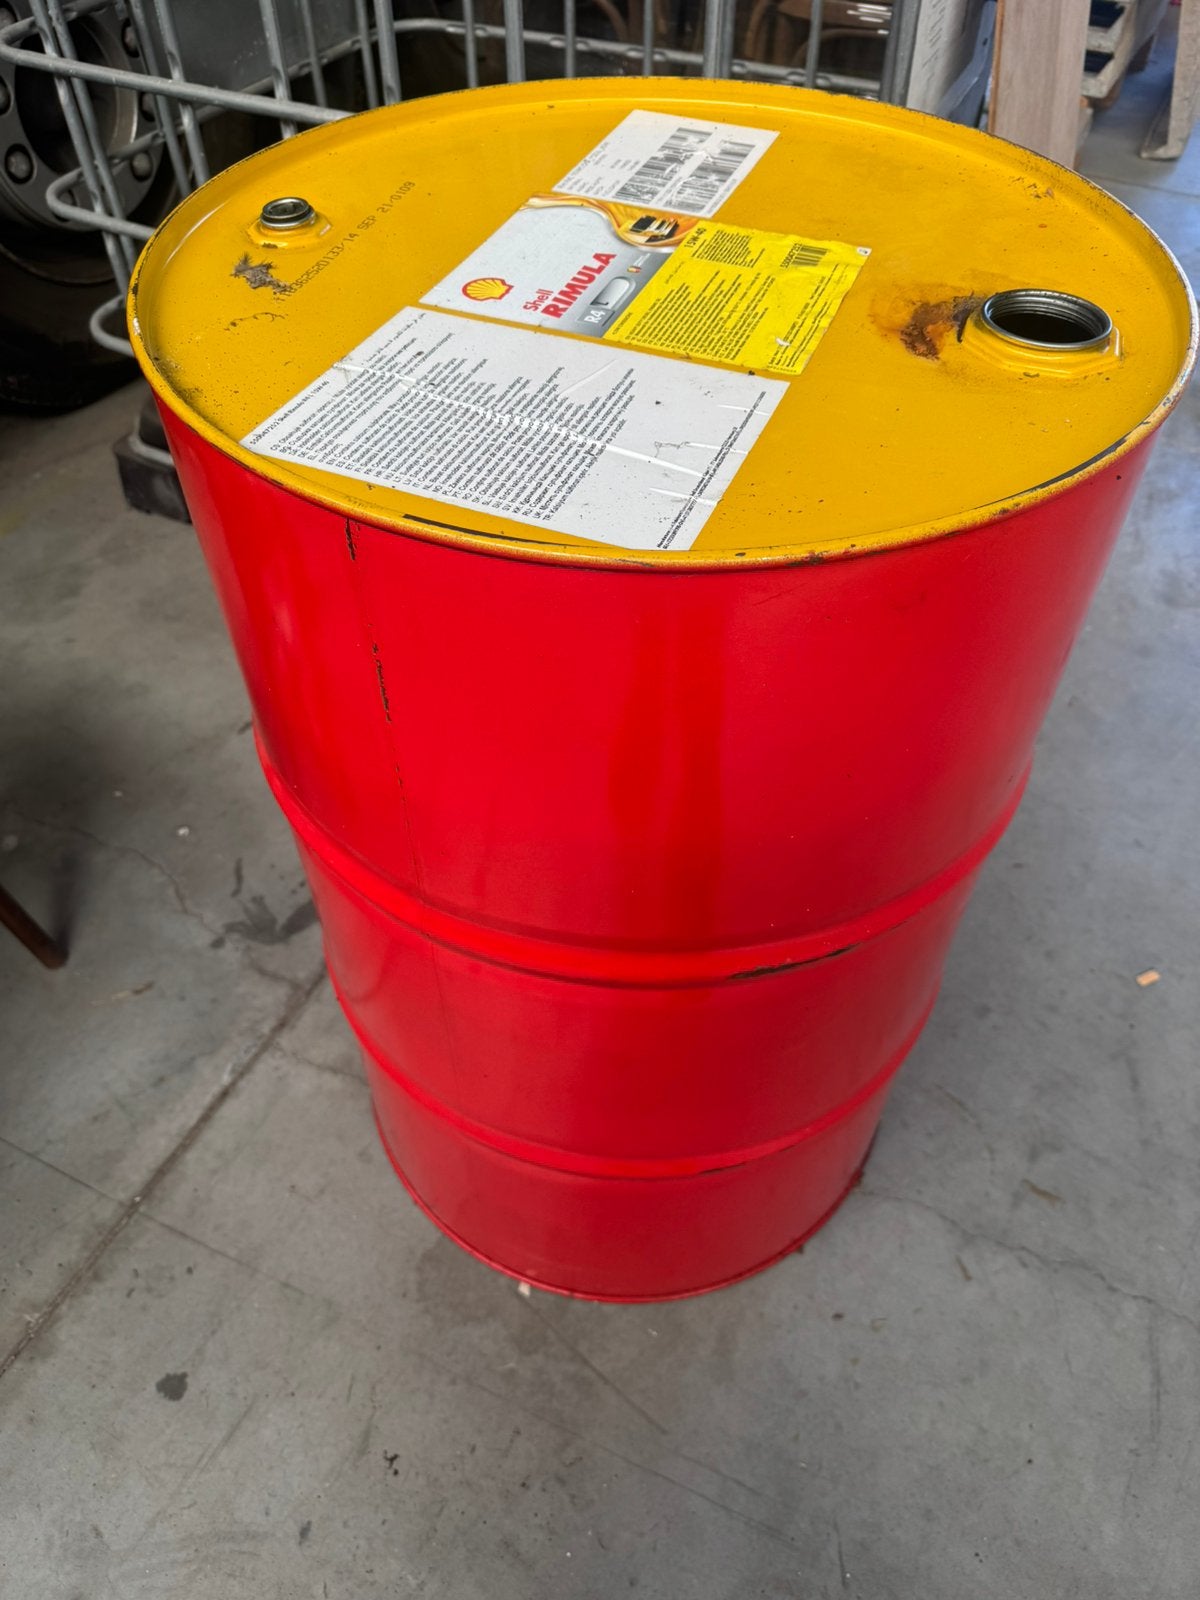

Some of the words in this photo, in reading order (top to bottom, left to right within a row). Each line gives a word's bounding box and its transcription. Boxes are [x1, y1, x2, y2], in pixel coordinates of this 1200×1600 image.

[357, 215, 376, 231] SEP
[541, 252, 617, 319] RIMULA
[522, 289, 554, 312] Shell
[584, 309, 606, 324] R4
